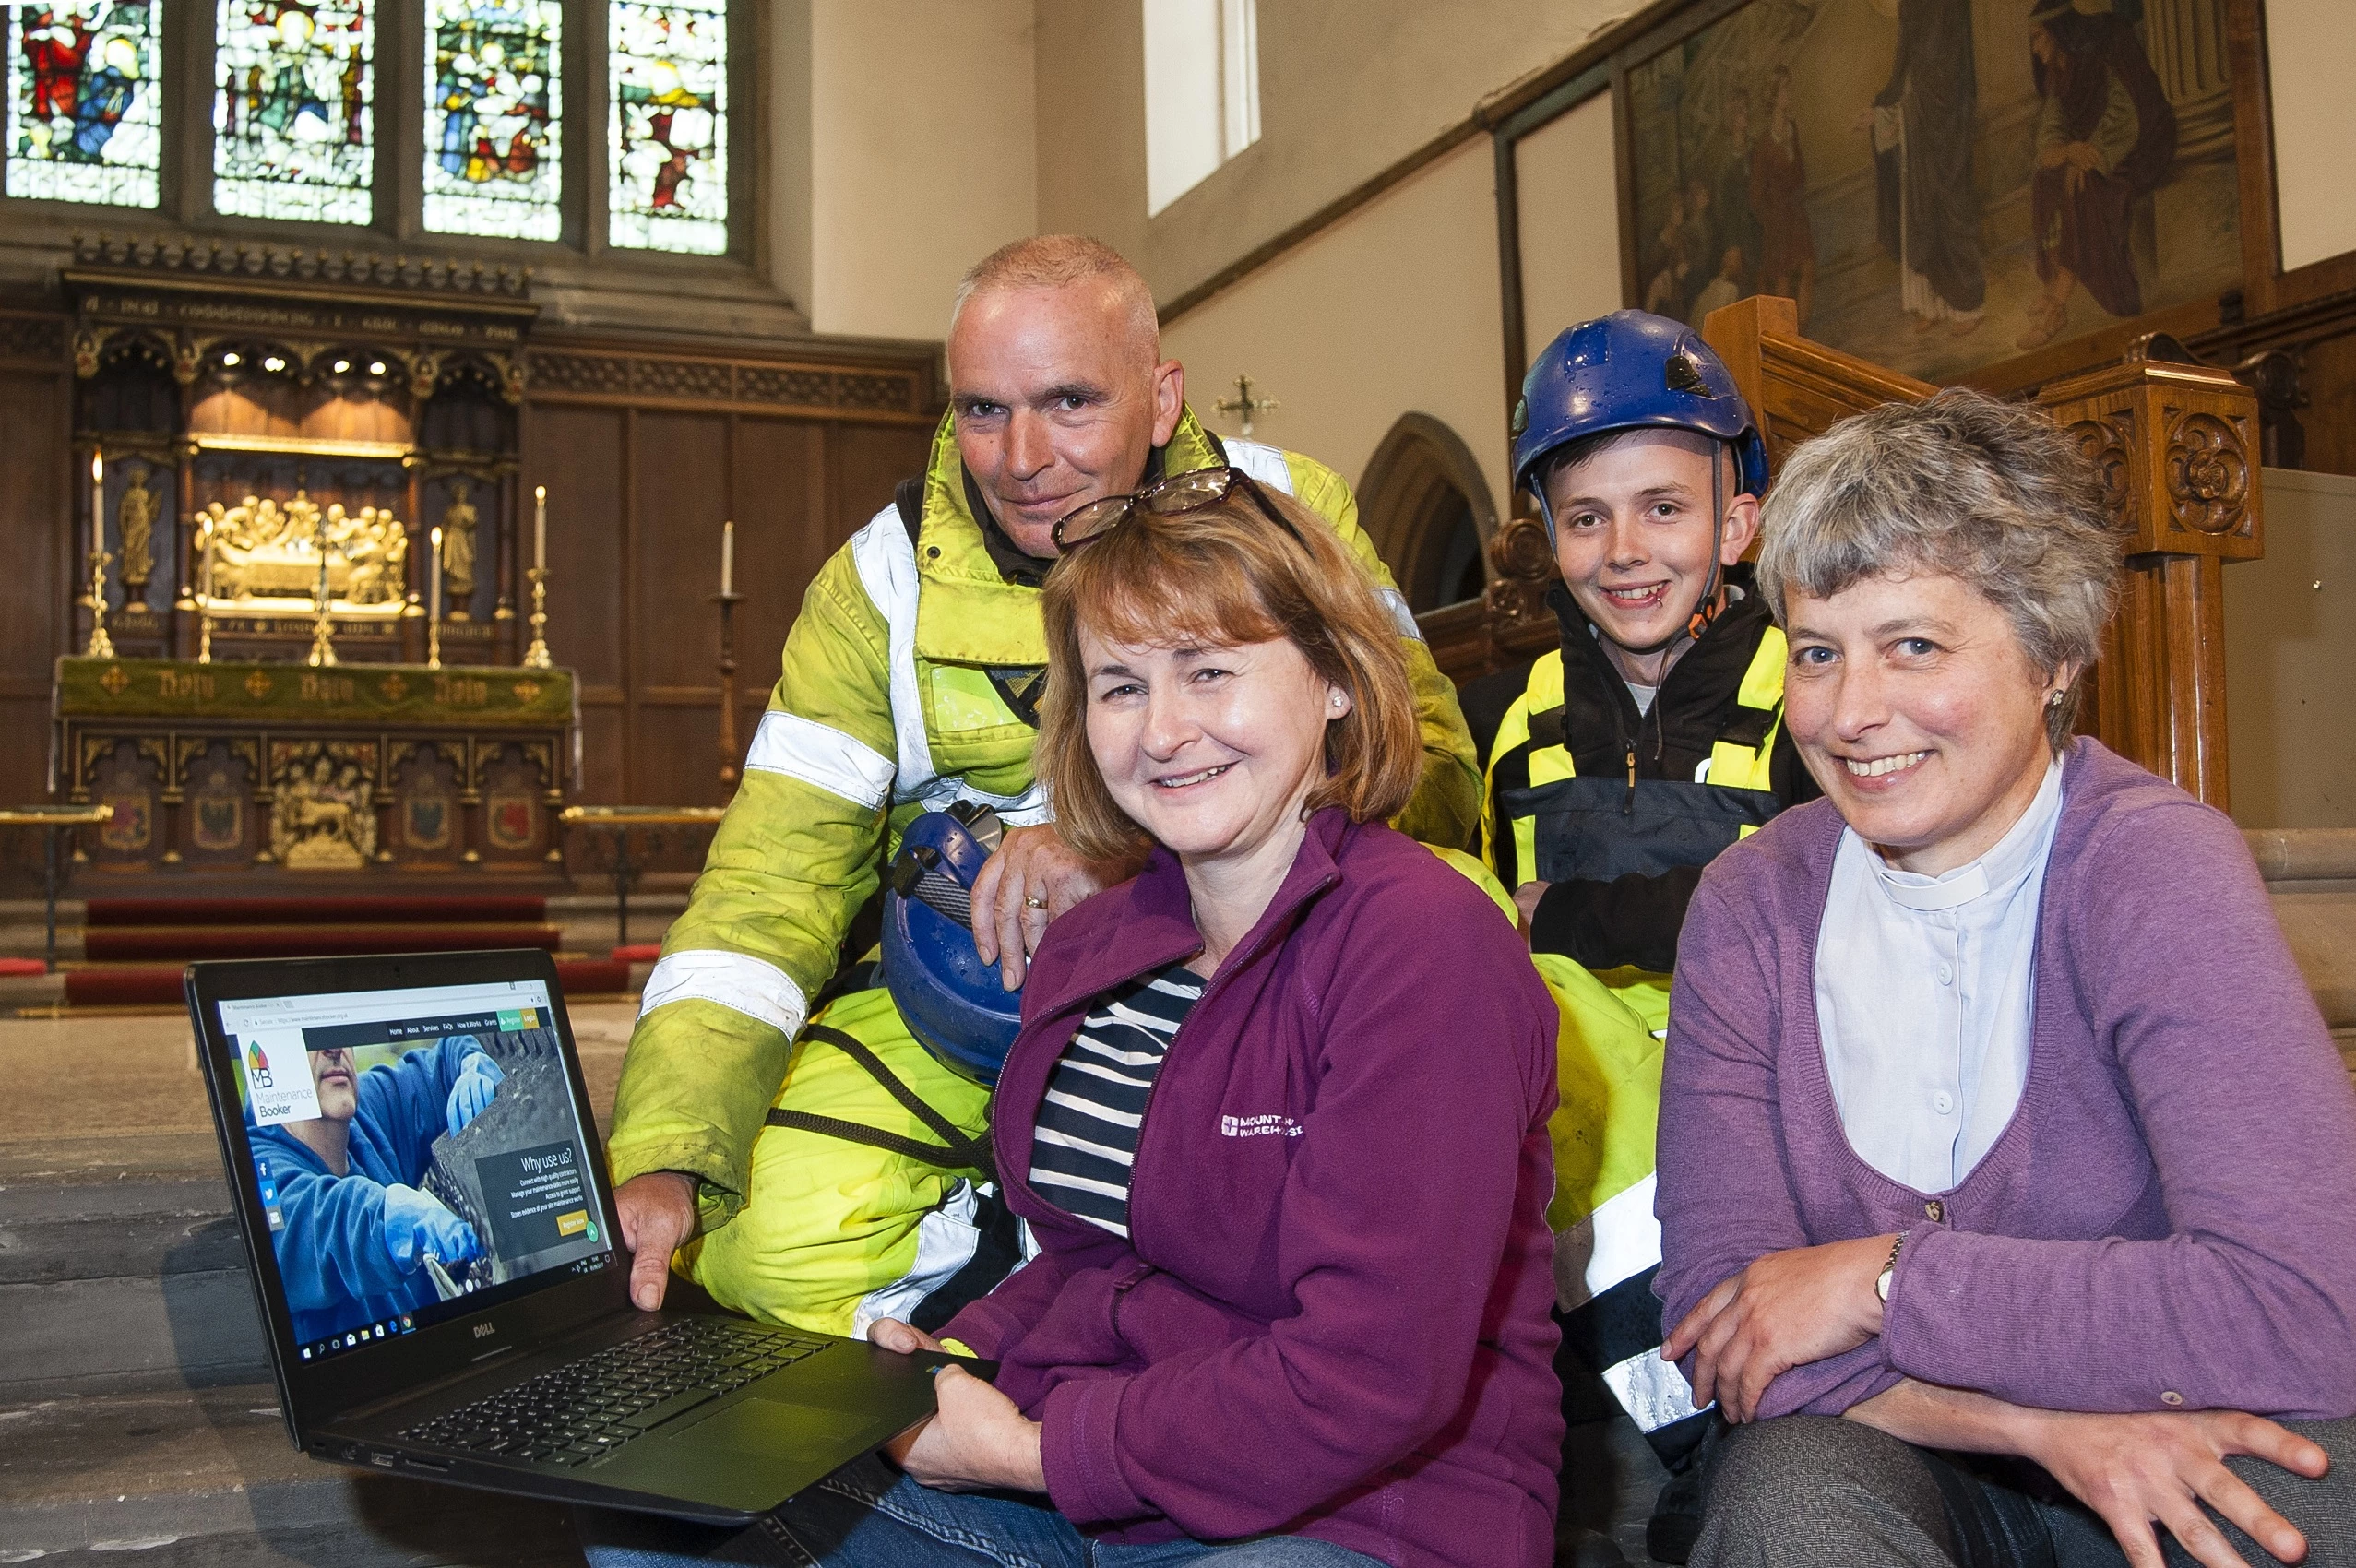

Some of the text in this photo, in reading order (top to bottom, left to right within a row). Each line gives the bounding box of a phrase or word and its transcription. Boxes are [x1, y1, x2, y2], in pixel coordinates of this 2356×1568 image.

[406, 1026, 420, 1034] About
[422, 1024, 439, 1033] Services
[251, 1067, 273, 1090] MB
[256, 1088, 314, 1105] Maintenance
[259, 1103, 292, 1118] Booker
[1240, 1114, 1295, 1127] MOUNTN
[520, 1147, 572, 1173] Why use us?
[473, 1322, 496, 1339] DELL
